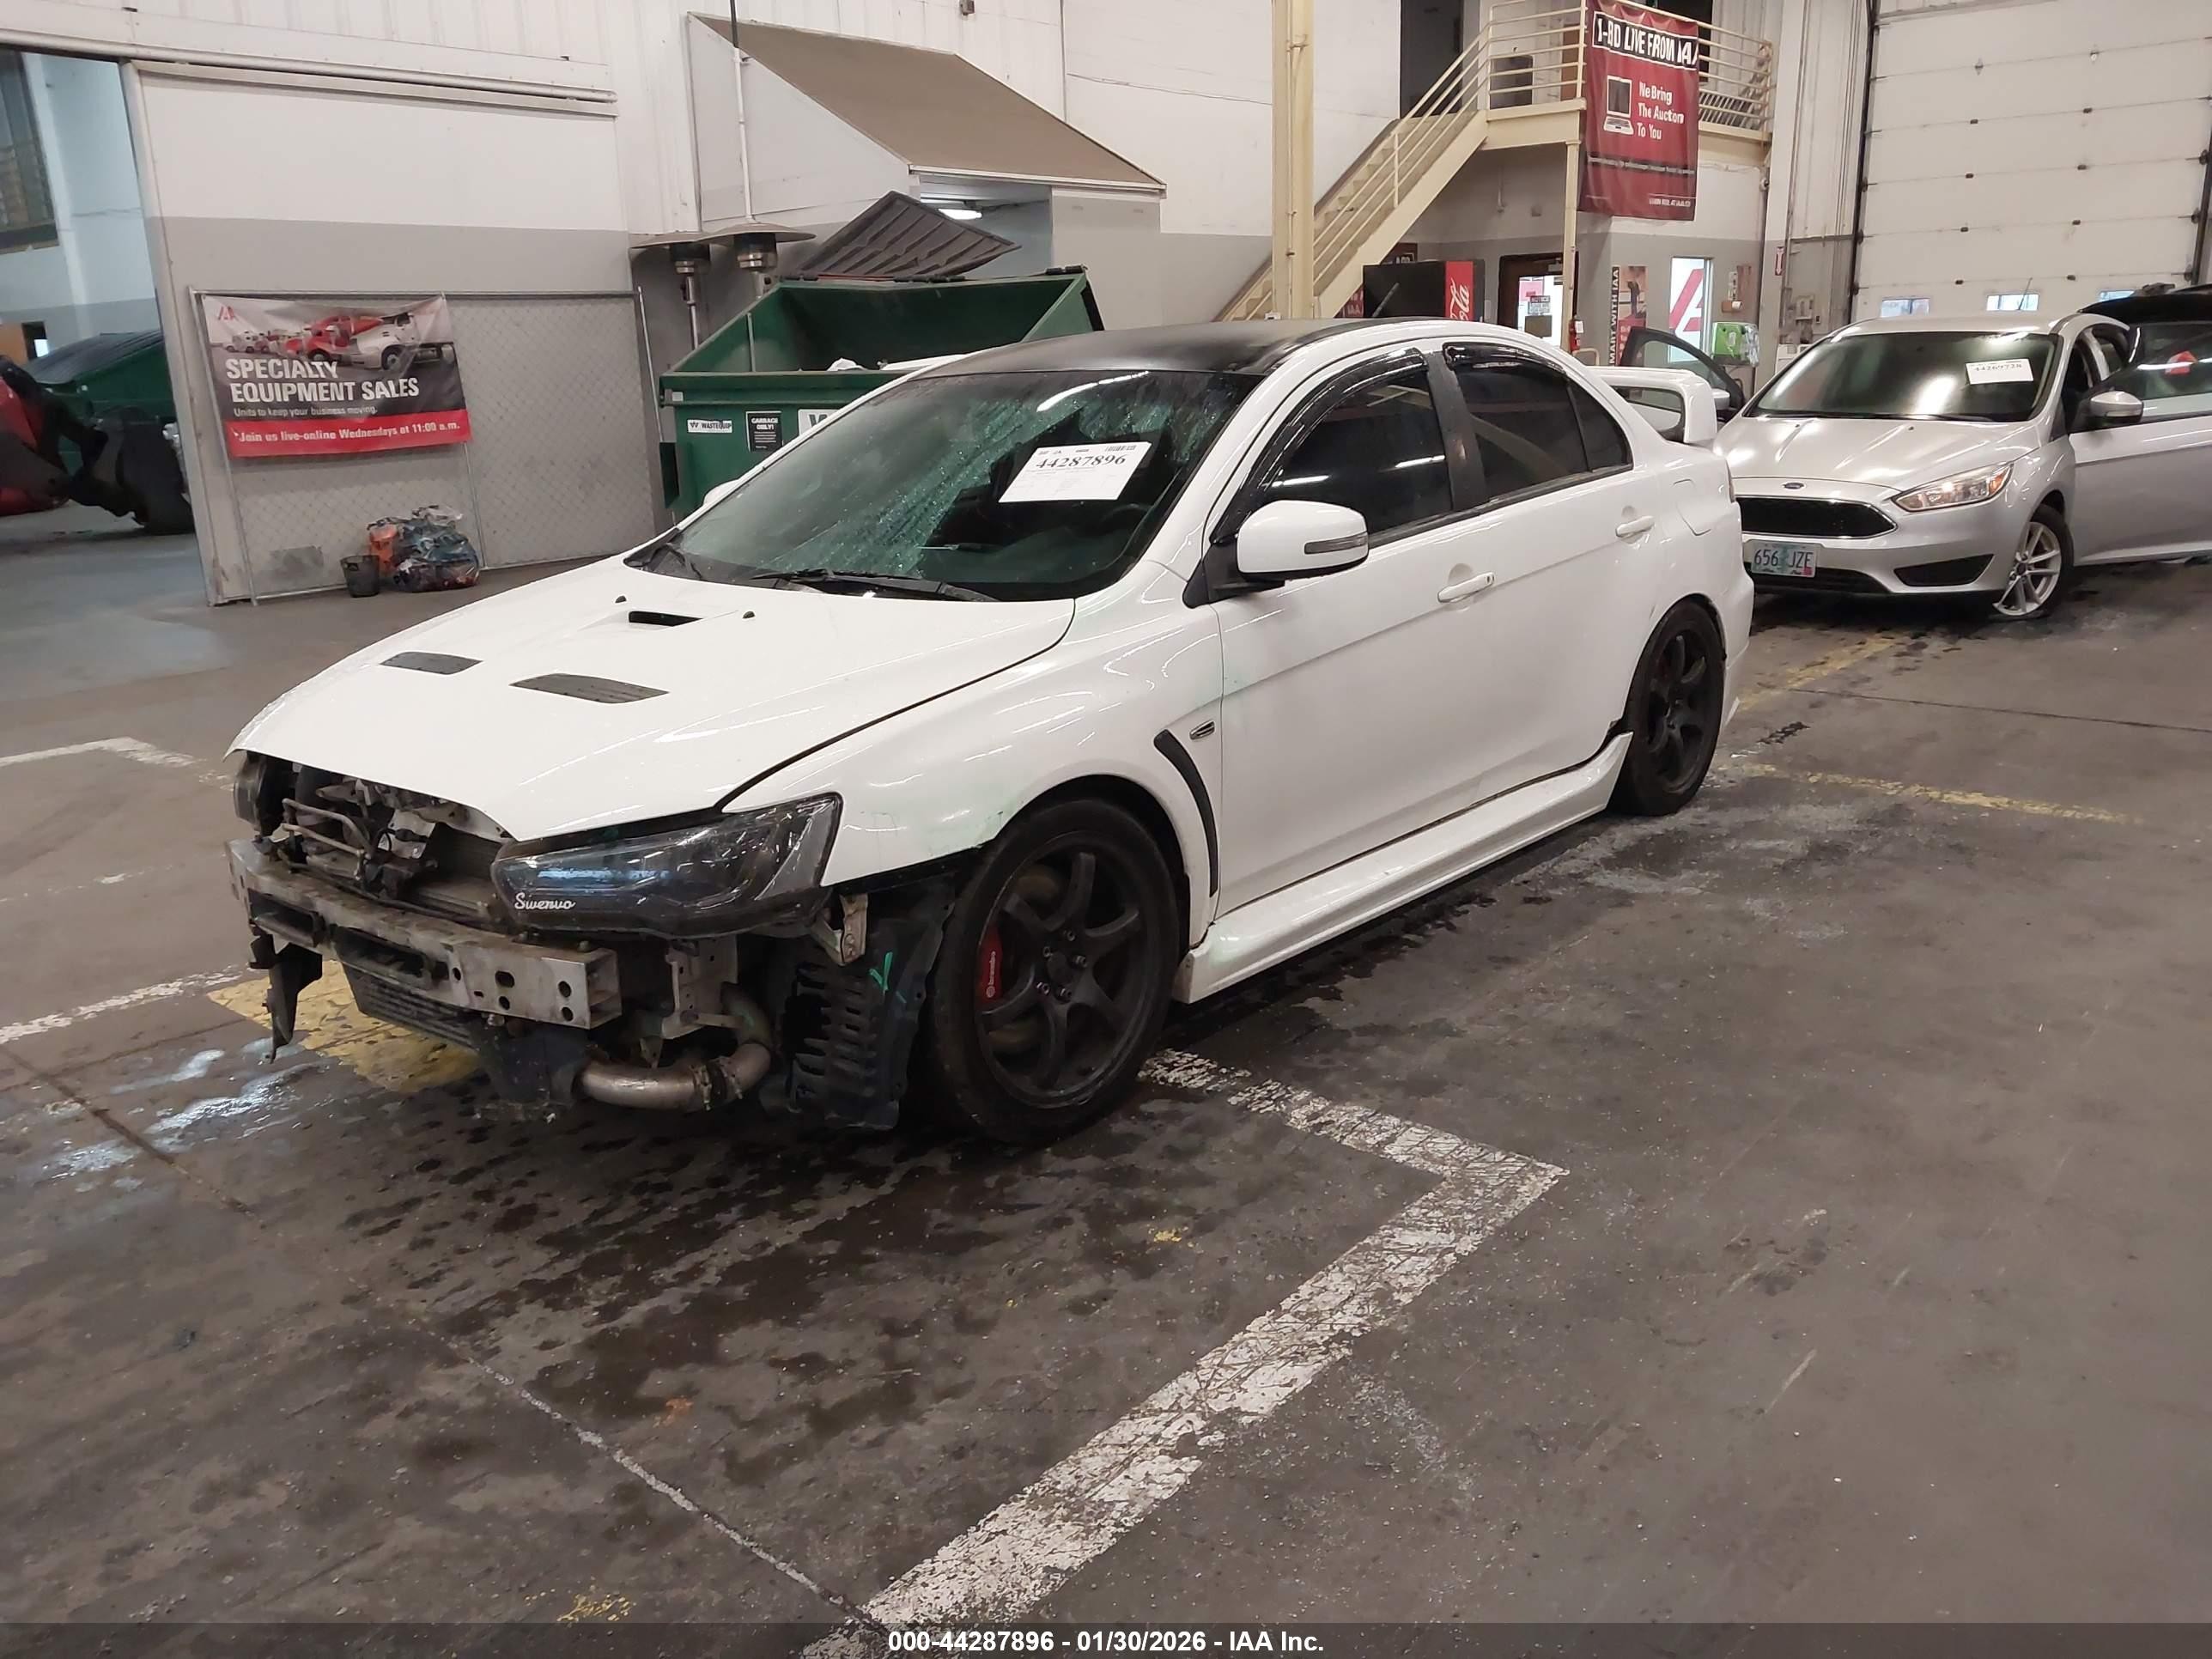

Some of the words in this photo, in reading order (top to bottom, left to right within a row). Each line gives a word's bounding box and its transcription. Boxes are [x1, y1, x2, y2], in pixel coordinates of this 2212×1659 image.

[1624, 26, 1645, 54] LIVE
[1647, 32, 1674, 62] FROM
[1651, 85, 1673, 106] Bring
[1638, 102, 1652, 118] The
[1637, 122, 1646, 137] To
[1649, 123, 1662, 140] You
[225, 358, 337, 380] SPECIALTY
[230, 381, 356, 403] EQUIPMENT
[361, 377, 420, 401] SALES
[234, 407, 256, 417] Units
[258, 408, 267, 416] to
[268, 407, 289, 418] keep
[289, 408, 308, 418] your
[311, 405, 346, 416] business
[265, 432, 278, 441] us
[281, 429, 337, 441] live-online
[338, 426, 398, 440] Wednesdays
[399, 426, 410, 434] at
[412, 422, 437, 434] 11:00
[439, 422, 461, 431] a.m.
[701, 422, 732, 430] WASTEQUIP
[1036, 453, 1127, 469] 44287896
[1753, 549, 1779, 567] 656
[1789, 551, 1814, 569] JZE
[514, 891, 576, 910] Swervo
